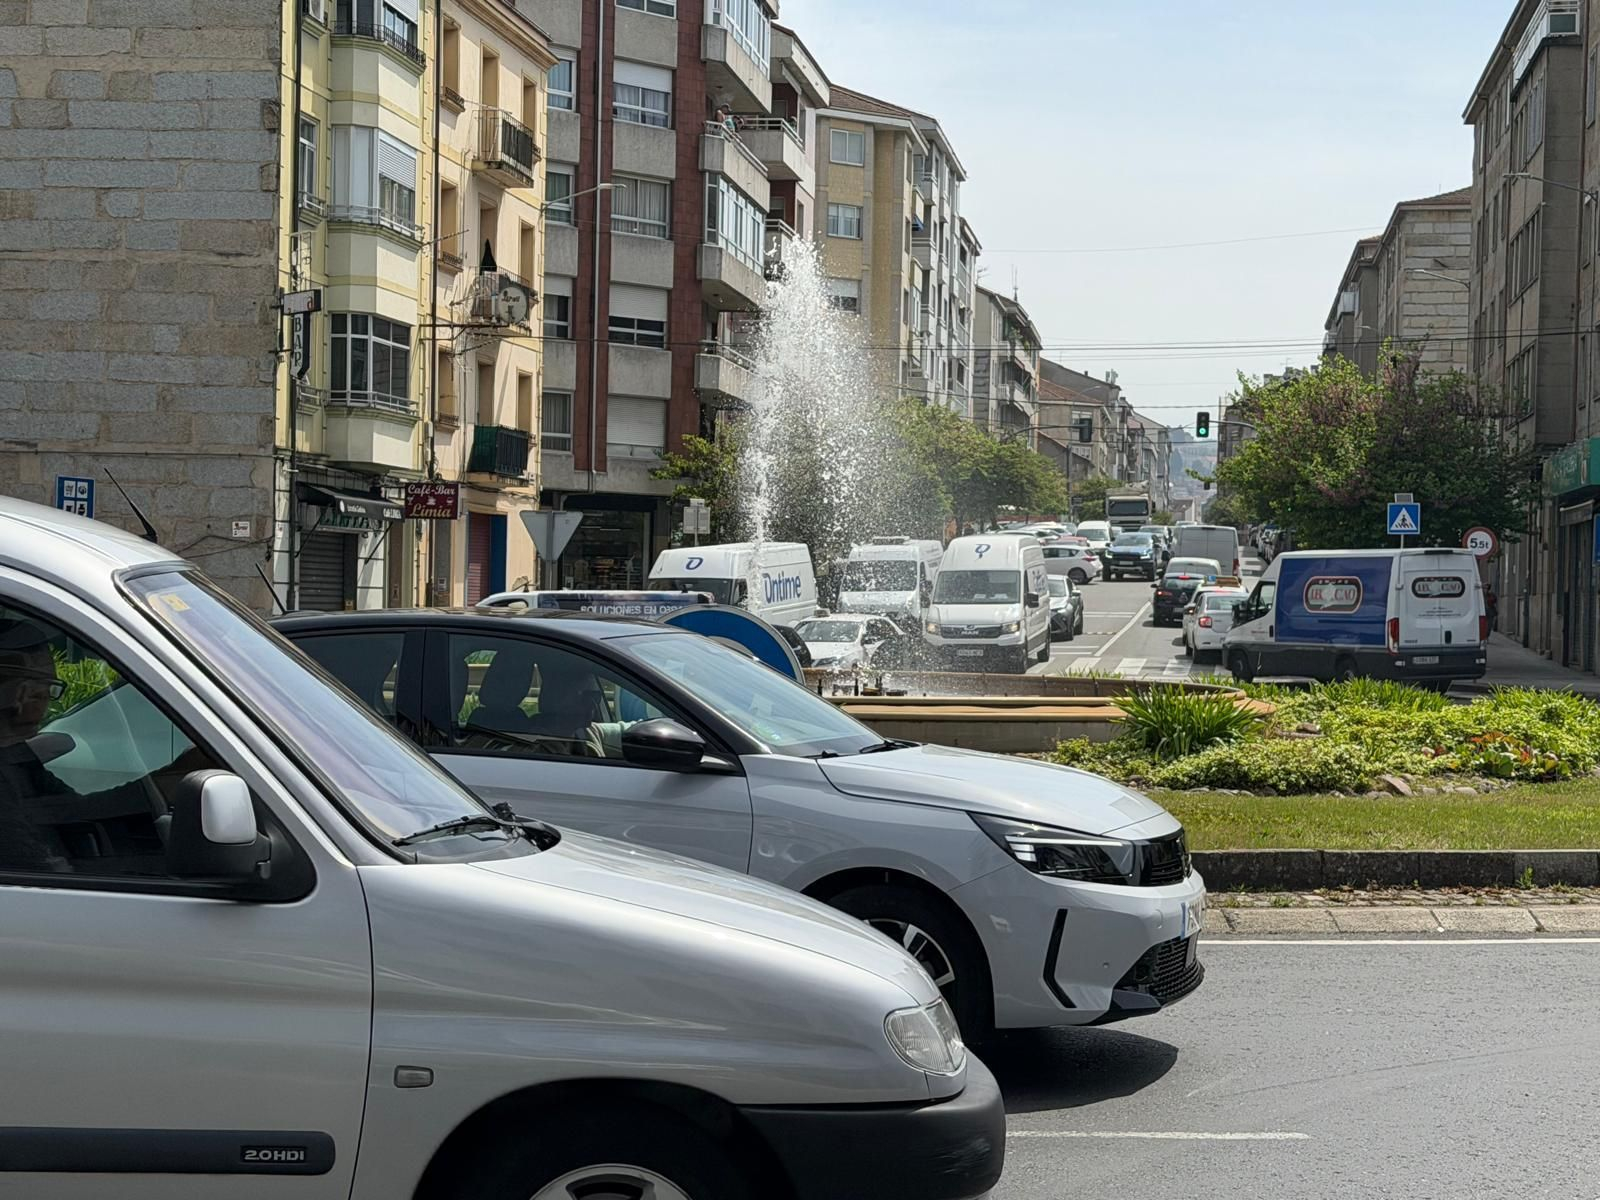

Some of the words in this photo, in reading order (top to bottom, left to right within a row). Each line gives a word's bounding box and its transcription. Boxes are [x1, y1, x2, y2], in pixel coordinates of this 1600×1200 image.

[294, 317, 302, 367] BAR
[407, 484, 455, 495] Café-Bar
[410, 504, 451, 518] Limia
[580, 605, 641, 616] SOLUCIONES
[644, 605, 657, 615] EN
